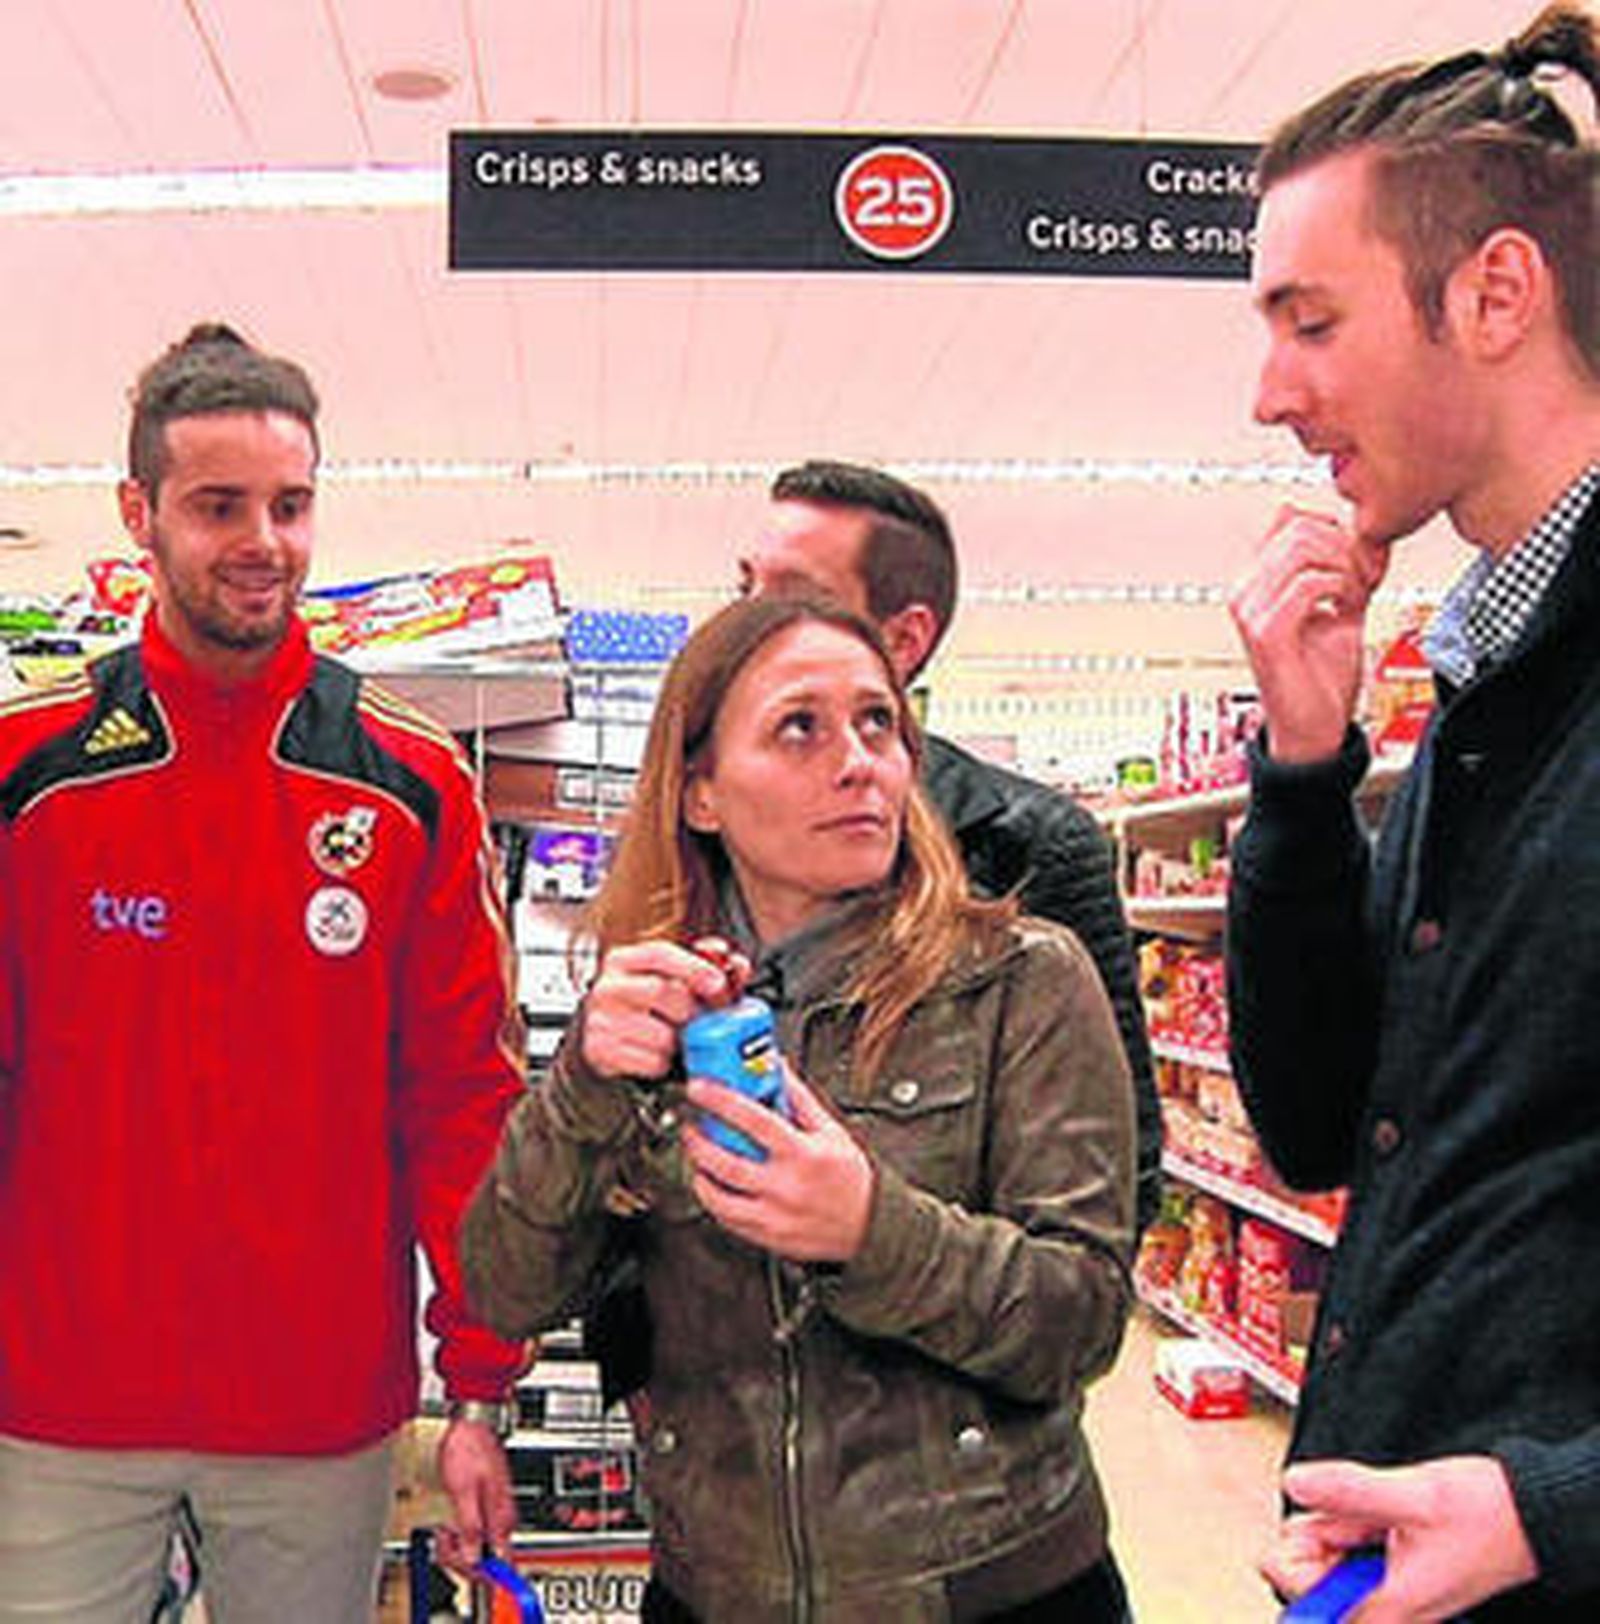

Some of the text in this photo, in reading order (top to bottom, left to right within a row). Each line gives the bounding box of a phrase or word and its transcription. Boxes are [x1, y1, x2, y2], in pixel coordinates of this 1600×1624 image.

[475, 151, 762, 190] Crisps & snacks
[855, 176, 934, 226] 25
[1027, 214, 1139, 253] Crisps
[1149, 218, 1175, 250] &
[90, 888, 167, 940] tve
